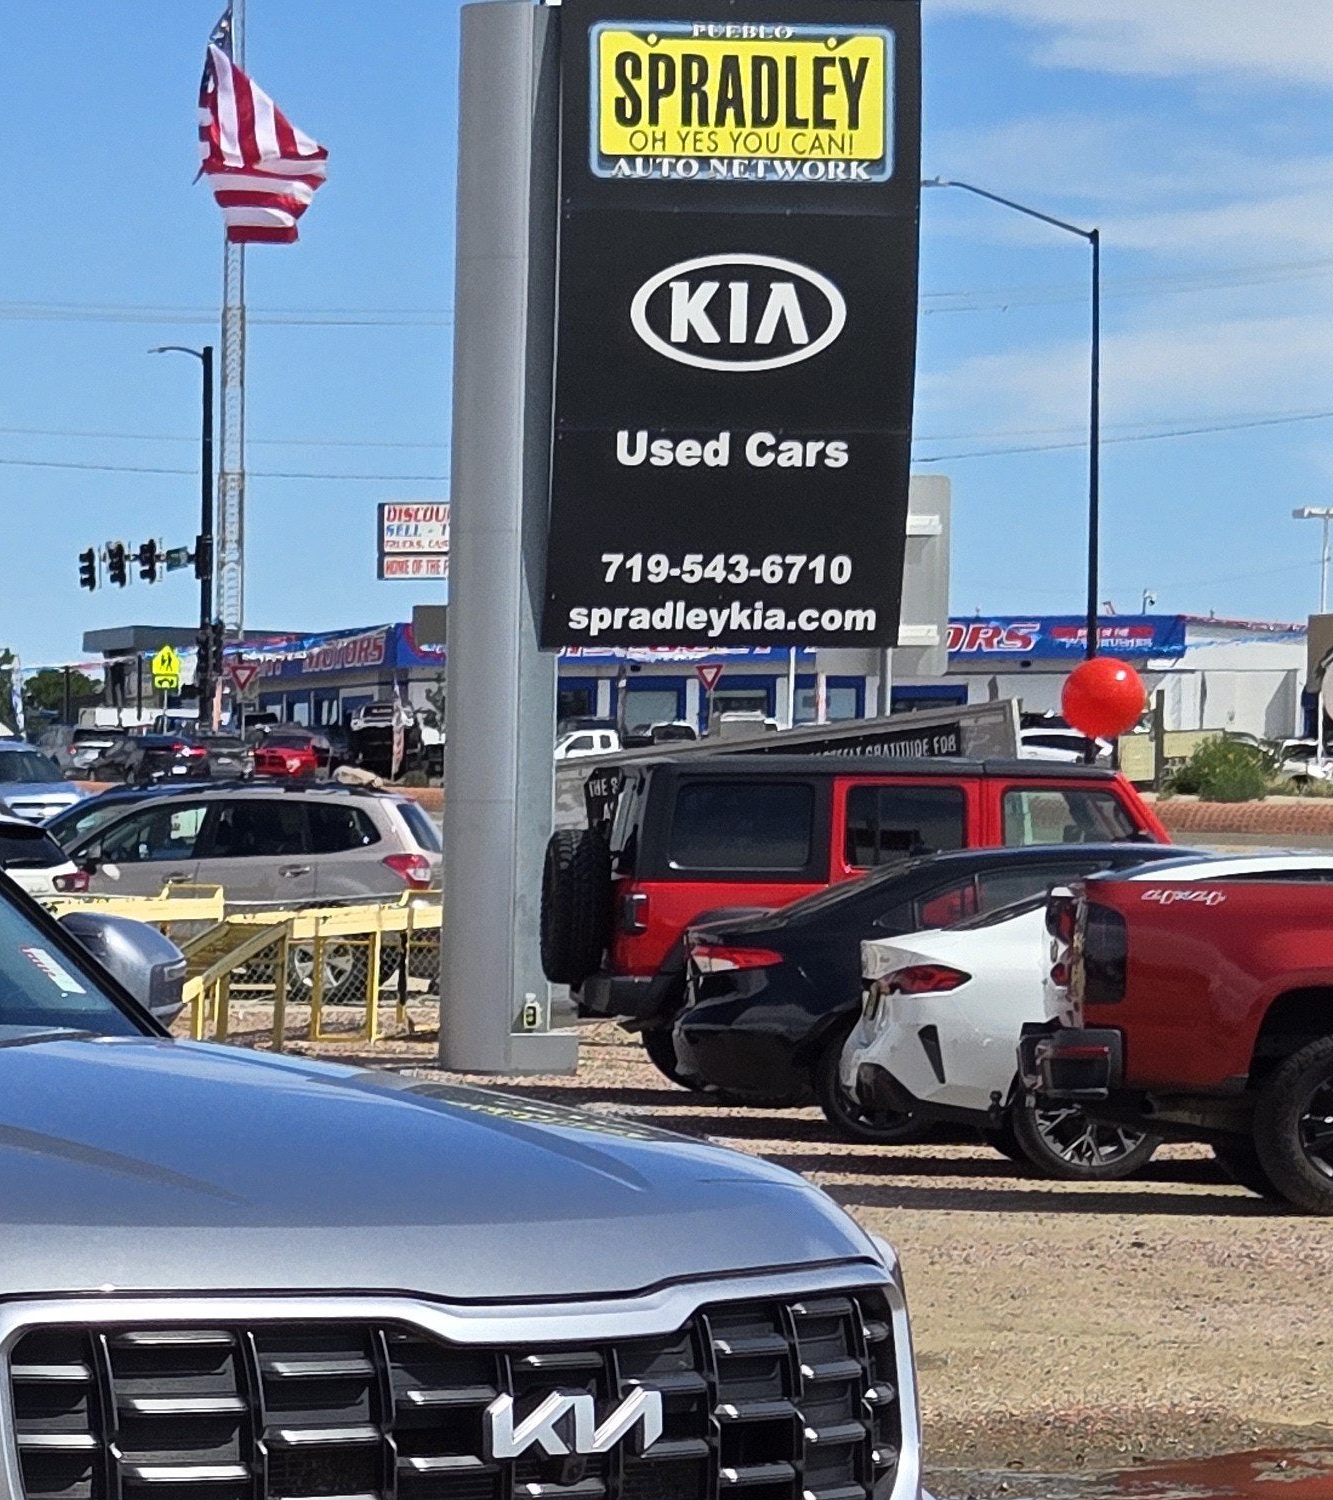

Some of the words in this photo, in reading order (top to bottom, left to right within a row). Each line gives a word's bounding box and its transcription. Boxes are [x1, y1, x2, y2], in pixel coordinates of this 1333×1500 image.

[691, 24, 794, 40] PUEBLO
[614, 51, 870, 130] SPRADLEY
[629, 130, 666, 151] OH
[676, 130, 719, 152] YES
[729, 131, 781, 154] YOU
[791, 132, 854, 155] CAN!
[610, 157, 700, 178] AUTO
[709, 159, 872, 180] NETWORK
[669, 281, 809, 344] KIA
[616, 430, 730, 466] Used
[745, 432, 849, 467] Cars
[386, 507, 450, 523] DISCOU
[601, 553, 852, 584] 719-543-6710
[568, 601, 877, 637] spradleykia.com
[946, 622, 1040, 652] ORS
[486, 1386, 663, 1458] KIA
